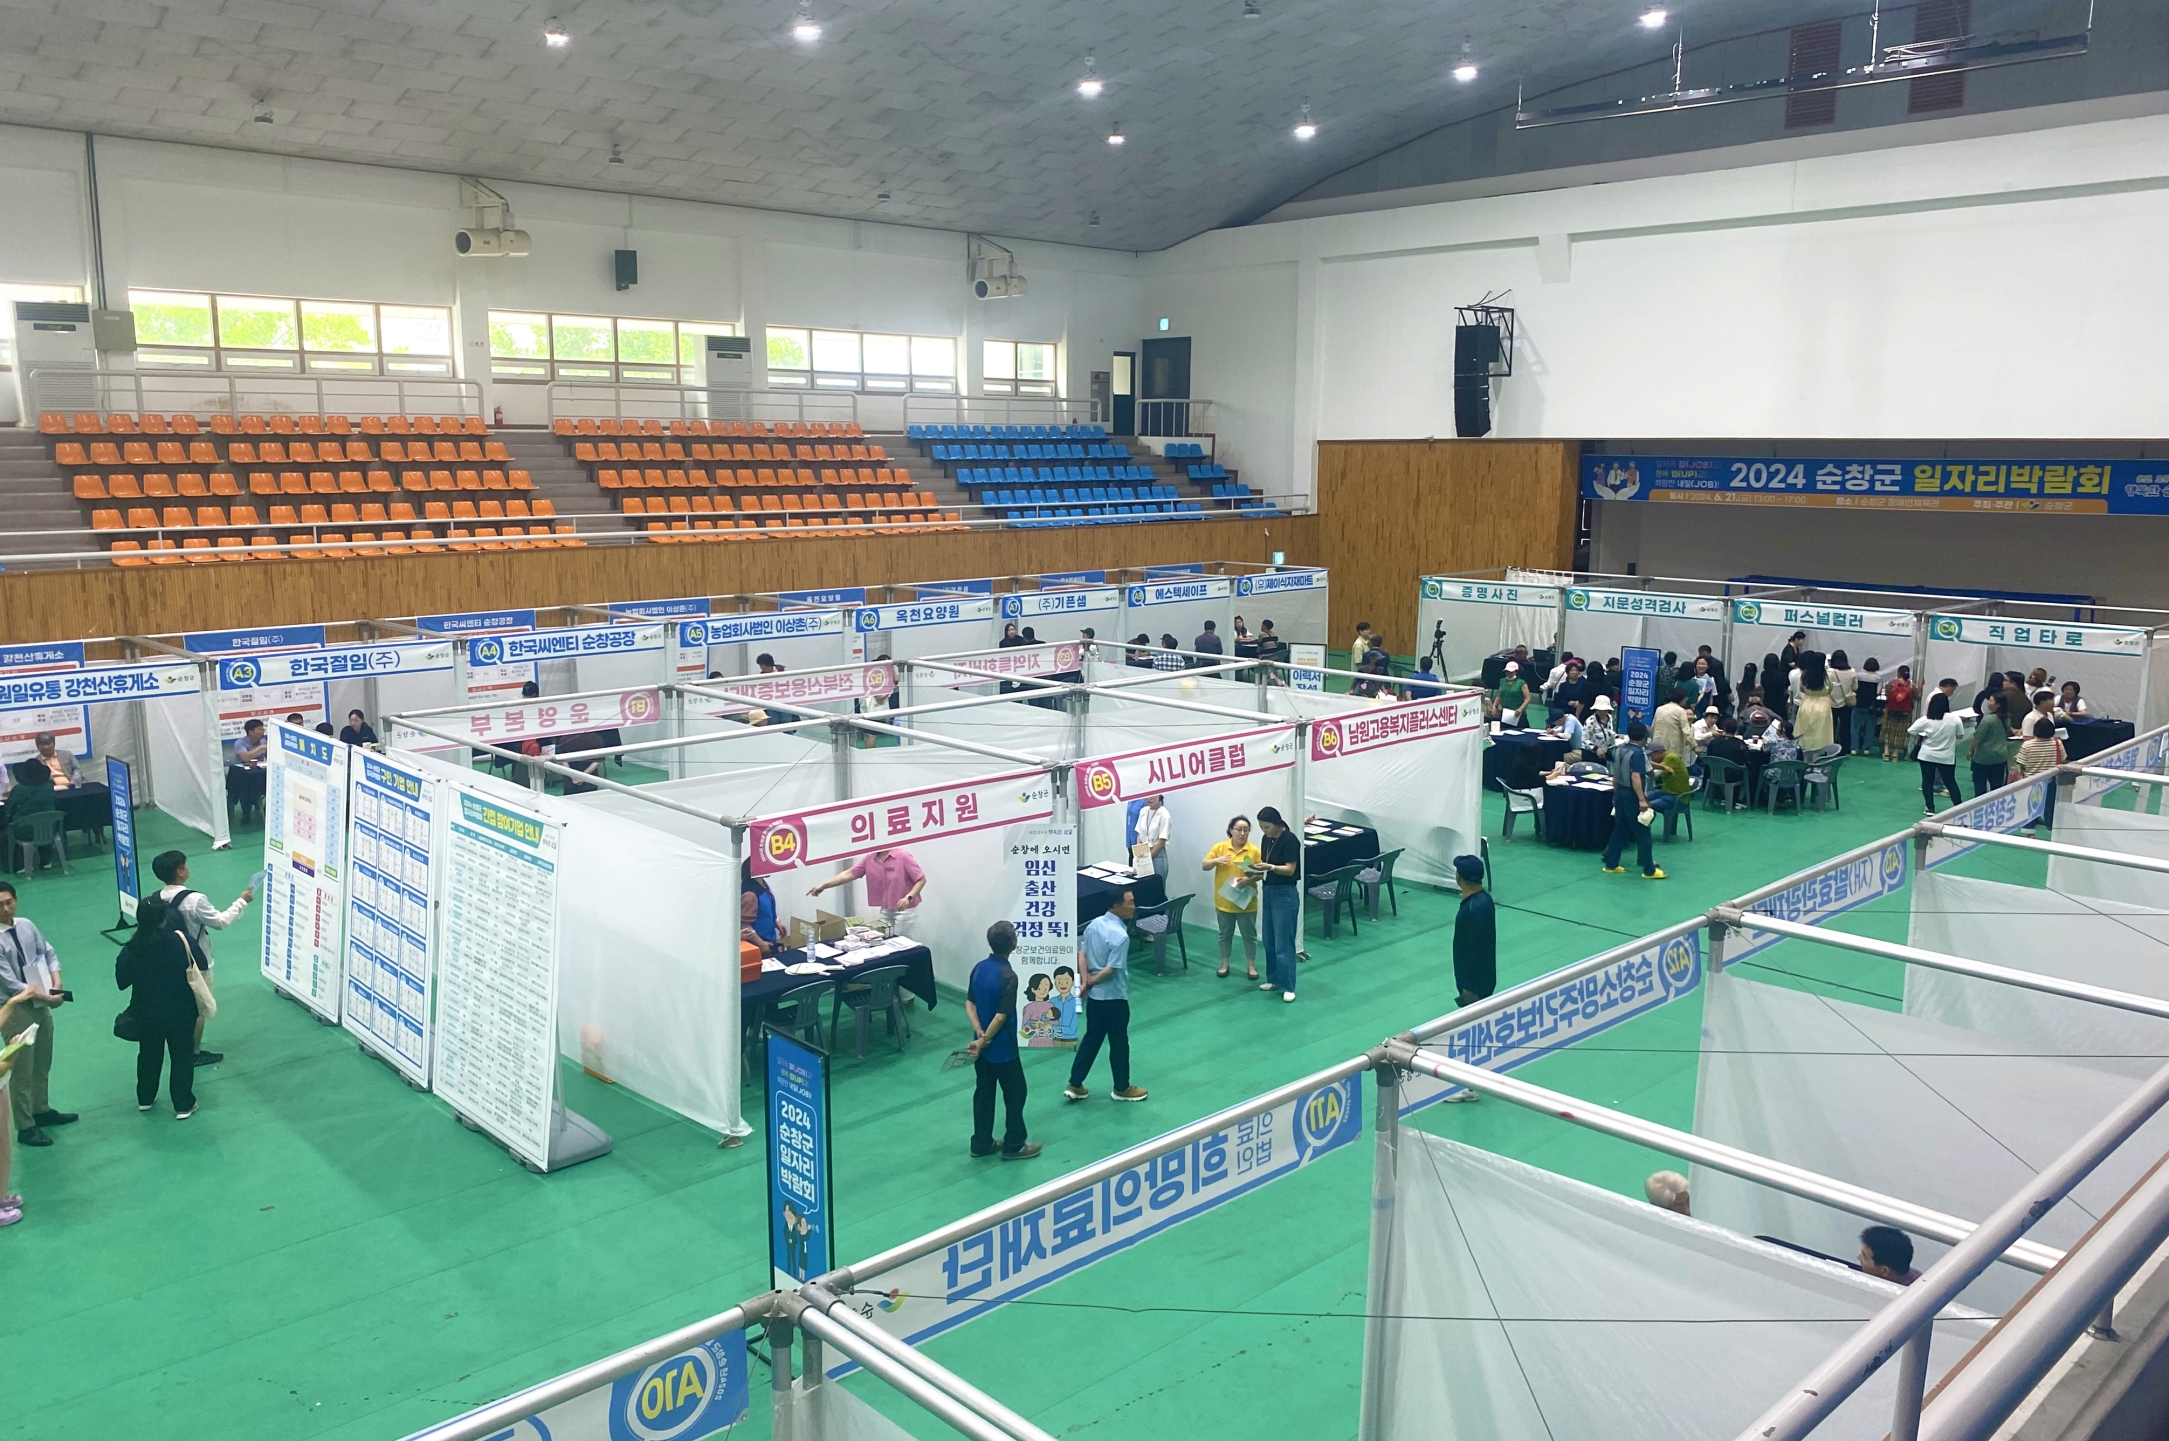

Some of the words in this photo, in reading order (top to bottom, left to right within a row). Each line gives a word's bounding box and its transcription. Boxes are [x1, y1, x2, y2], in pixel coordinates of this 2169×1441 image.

[1729, 462, 1806, 489] 2024
[1815, 463, 1902, 491] 순창군
[1913, 464, 2112, 495] 일자리박람회
[806, 594, 841, 603] 옥천요양원
[1155, 584, 1208, 601] 에스텍세이프
[1428, 585, 1438, 595] C1
[1461, 585, 1518, 602] 증명사진
[1038, 594, 1087, 611] (주)기픈샘
[1573, 596, 1585, 604] C2
[1602, 596, 1687, 615] 지문성격검사
[863, 616, 875, 624] A6
[896, 605, 960, 623] 옥천요양원
[1741, 606, 1757, 618] C3
[1783, 607, 1863, 629] 퍼스널컬러
[443, 618, 482, 629] 한국씨엔티
[484, 617, 513, 627] 순창공장
[710, 622, 773, 640] 농업회사법인
[776, 616, 822, 633] 이상촌(주)
[1939, 623, 1957, 635] C4
[232, 634, 284, 647] 한국절임(주)
[689, 629, 702, 639] A5
[1988, 625, 2083, 646] 직업타로
[481, 644, 498, 657] A4
[508, 635, 579, 657] 한국씨엔티
[582, 631, 636, 649] 순창공장
[3, 650, 65, 663] 강천산휴게소
[289, 651, 400, 677] 한국절임(주)
[233, 666, 254, 680] A3
[1293, 669, 1321, 682] 이력서
[1630, 671, 1648, 679] 2024
[65, 672, 159, 698] 강천산휴게소
[1628, 679, 1650, 688] 순창군
[1627, 688, 1649, 697] 일자리
[1348, 704, 1458, 746] 남원고용복지플러스센터
[1323, 731, 1337, 747] B6
[1148, 743, 1246, 784] 시니어클럽
[381, 768, 393, 787] 구인
[393, 773, 405, 792] 기업
[406, 779, 419, 798] 안내
[1091, 773, 1112, 792] B5
[1032, 788, 1049, 801] 순창군
[850, 792, 979, 843] 의료지원
[525, 822, 541, 845] 안내
[770, 832, 796, 856] B4
[1011, 844, 1039, 855] 순창에
[1042, 844, 1070, 855] 오시면
[1025, 860, 1056, 876] 임신
[1024, 880, 1057, 897] 출산
[1024, 901, 1056, 917] 건강
[1012, 921, 1043, 938] 걱정
[1047, 921, 1069, 938] 뚝!
[1010, 945, 1073, 955] 창군보건의료원이
[1021, 956, 1060, 965] 함께합니다.
[1038, 1027, 1063, 1038] 순창군
[781, 1100, 811, 1131] 2024
[779, 1122, 814, 1157] 순창군
[780, 1143, 814, 1181] 일자리
[780, 1167, 815, 1204] 박람회
